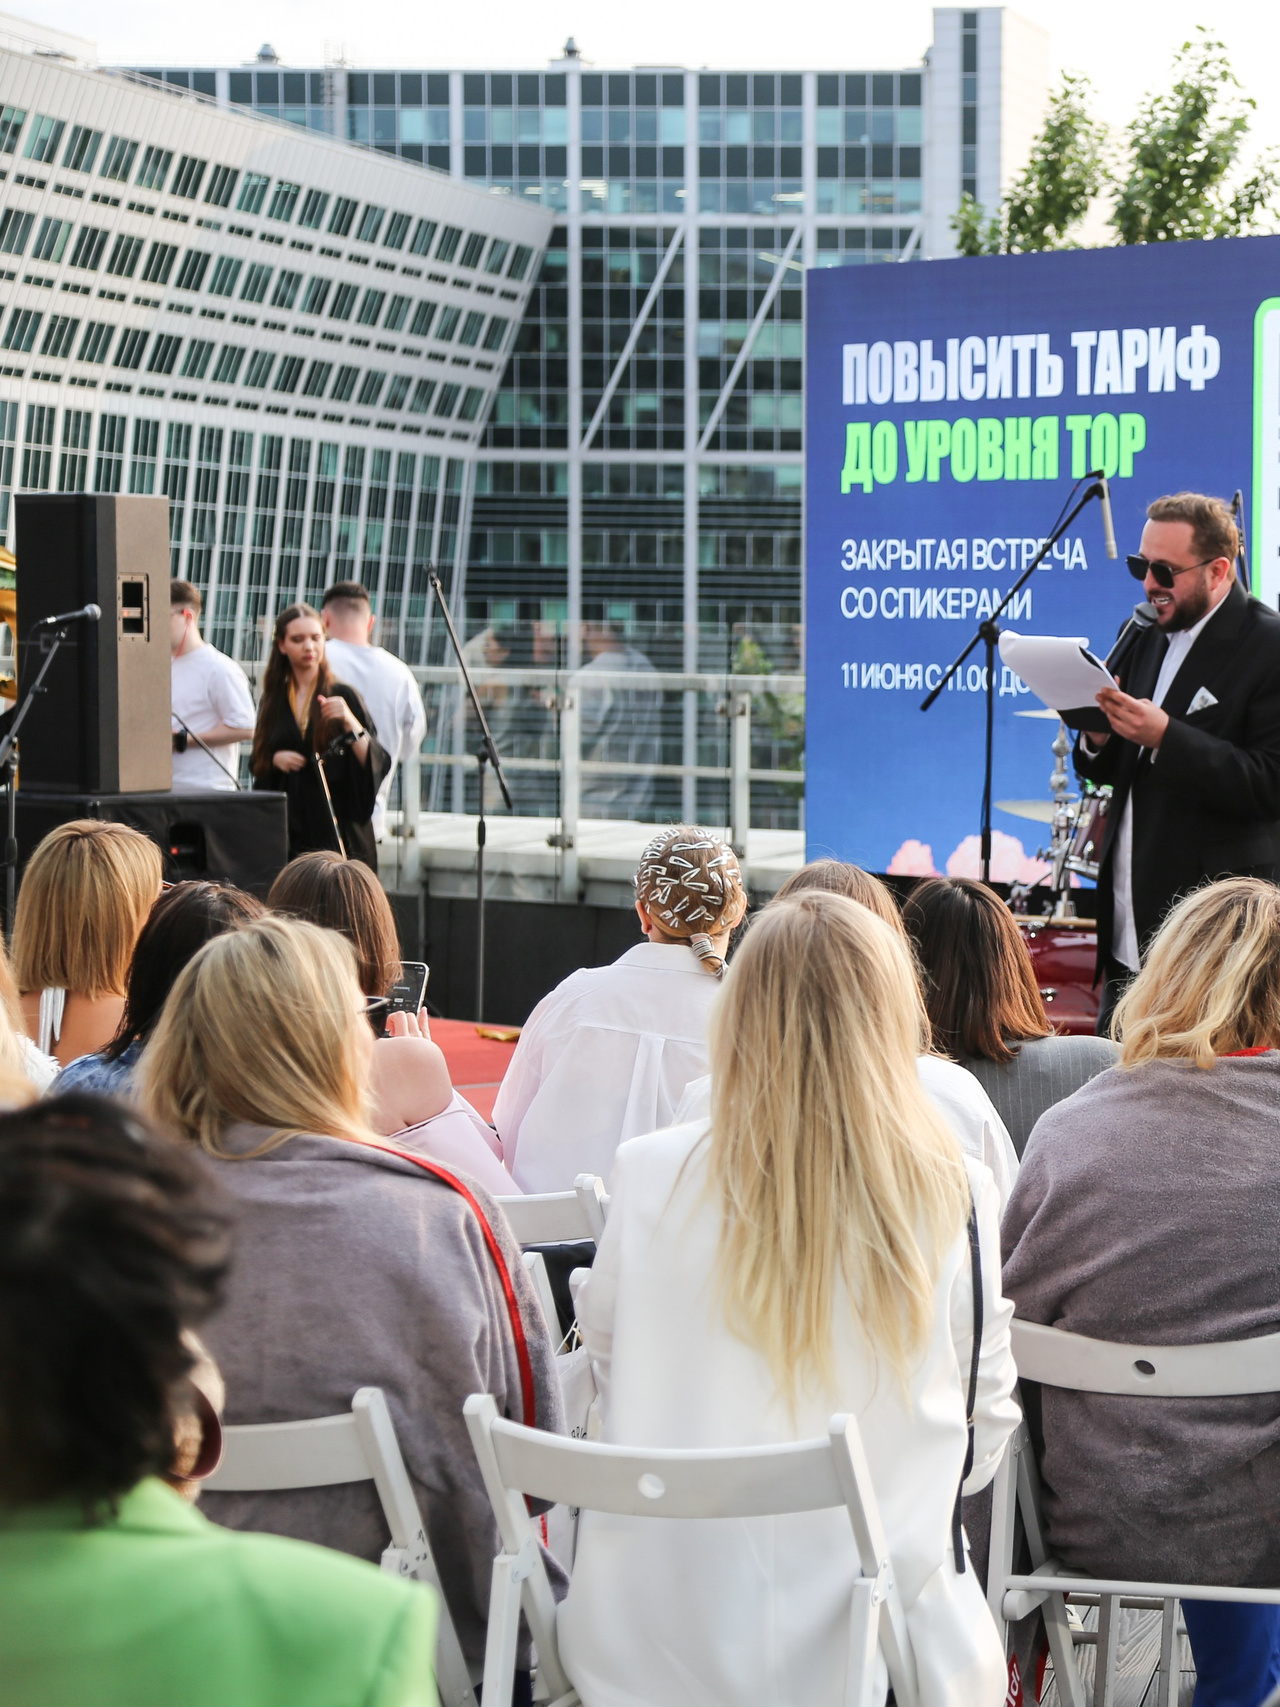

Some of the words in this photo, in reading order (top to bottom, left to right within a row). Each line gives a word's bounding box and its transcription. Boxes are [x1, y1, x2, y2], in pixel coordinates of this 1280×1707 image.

[842, 333, 1064, 405] ПОВЫСИТЬ
[1071, 324, 1221, 396] ТАРИФ
[840, 420, 898, 494] ДО
[904, 416, 1059, 483] УРОВНЯ
[840, 538, 967, 571] ЗАКРЫТАЯ
[972, 537, 1088, 570] ВСТРЕЧА
[840, 587, 877, 619] СО
[880, 587, 1032, 620] СПИКЕРАМИ
[841, 662, 858, 689] 11
[861, 662, 922, 690] ИЮНЯ
[925, 664, 942, 691] С
